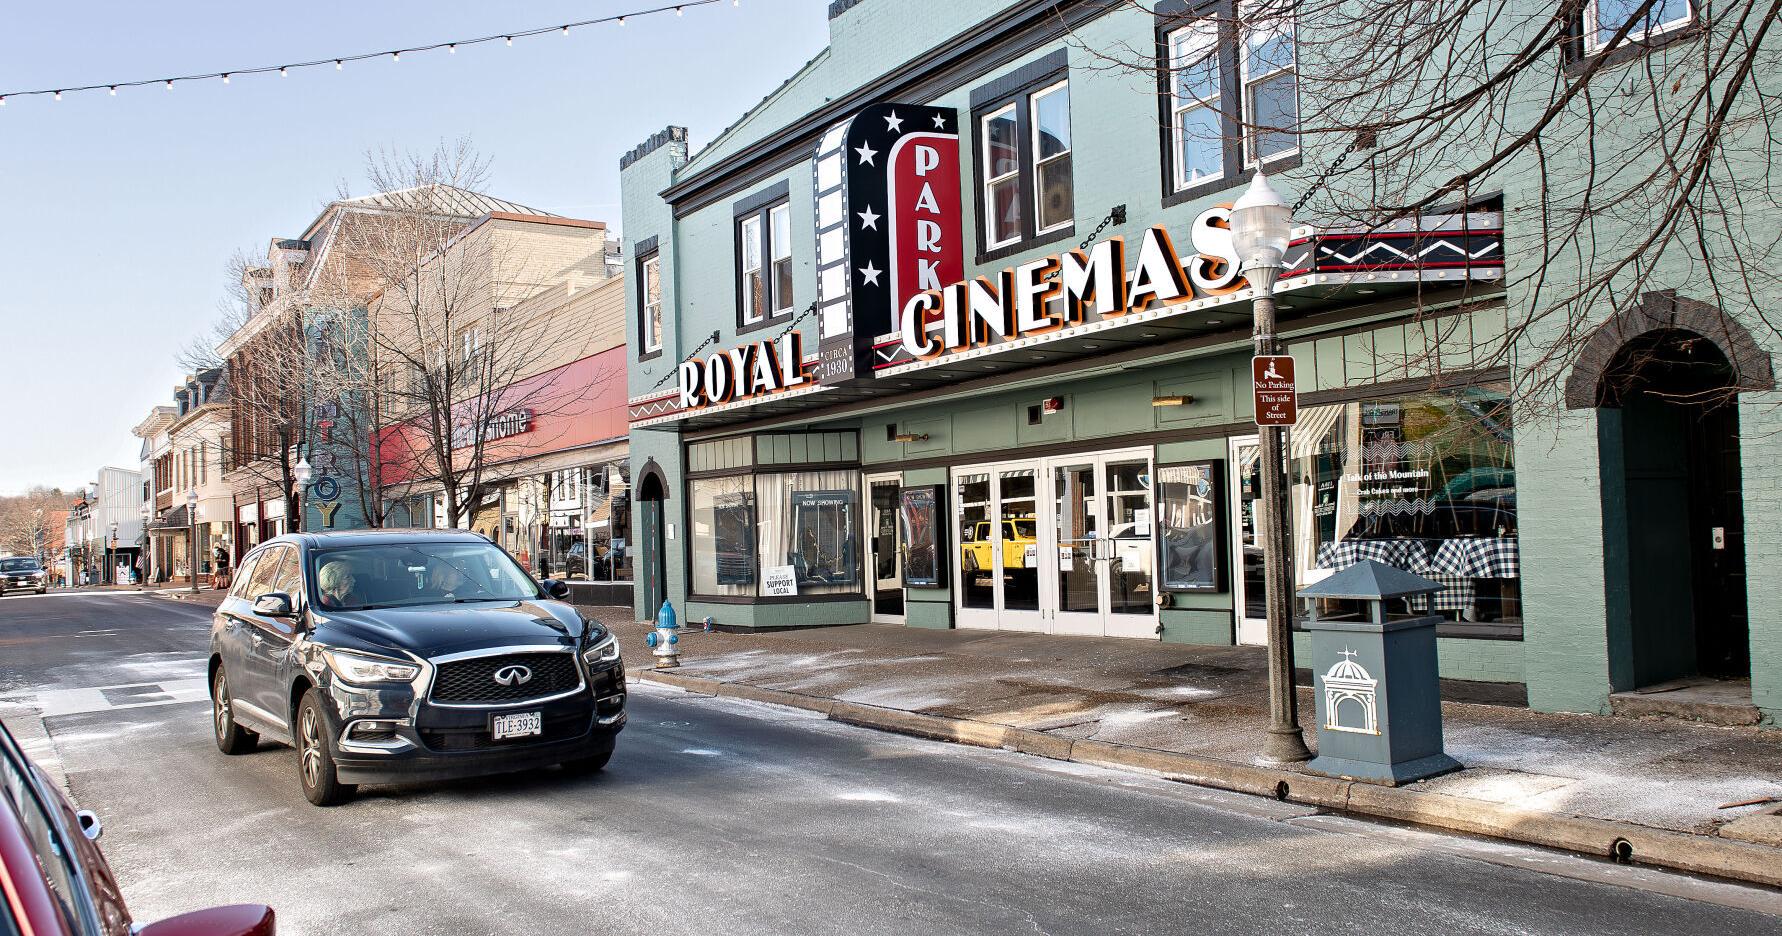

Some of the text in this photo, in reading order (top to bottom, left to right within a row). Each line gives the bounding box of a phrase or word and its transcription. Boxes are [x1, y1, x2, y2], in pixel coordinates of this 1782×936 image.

[914, 144, 943, 292] PARK
[901, 203, 1247, 360] CINEMAS
[825, 347, 848, 361] CIRCA
[679, 330, 813, 411] ROYAL
[827, 358, 848, 377] 1930
[1255, 381, 1294, 390] No Parking
[1261, 394, 1290, 403] This side
[1266, 411, 1287, 419] Street
[1346, 468, 1429, 481] Talk of the Mountain
[1356, 488, 1371, 496] Crab
[1371, 486, 1390, 495] Cakes
[1391, 486, 1402, 494] and
[766, 579, 794, 589] SUPPORT
[773, 587, 790, 595] LOCAL
[496, 717, 539, 733] TLE-3932
